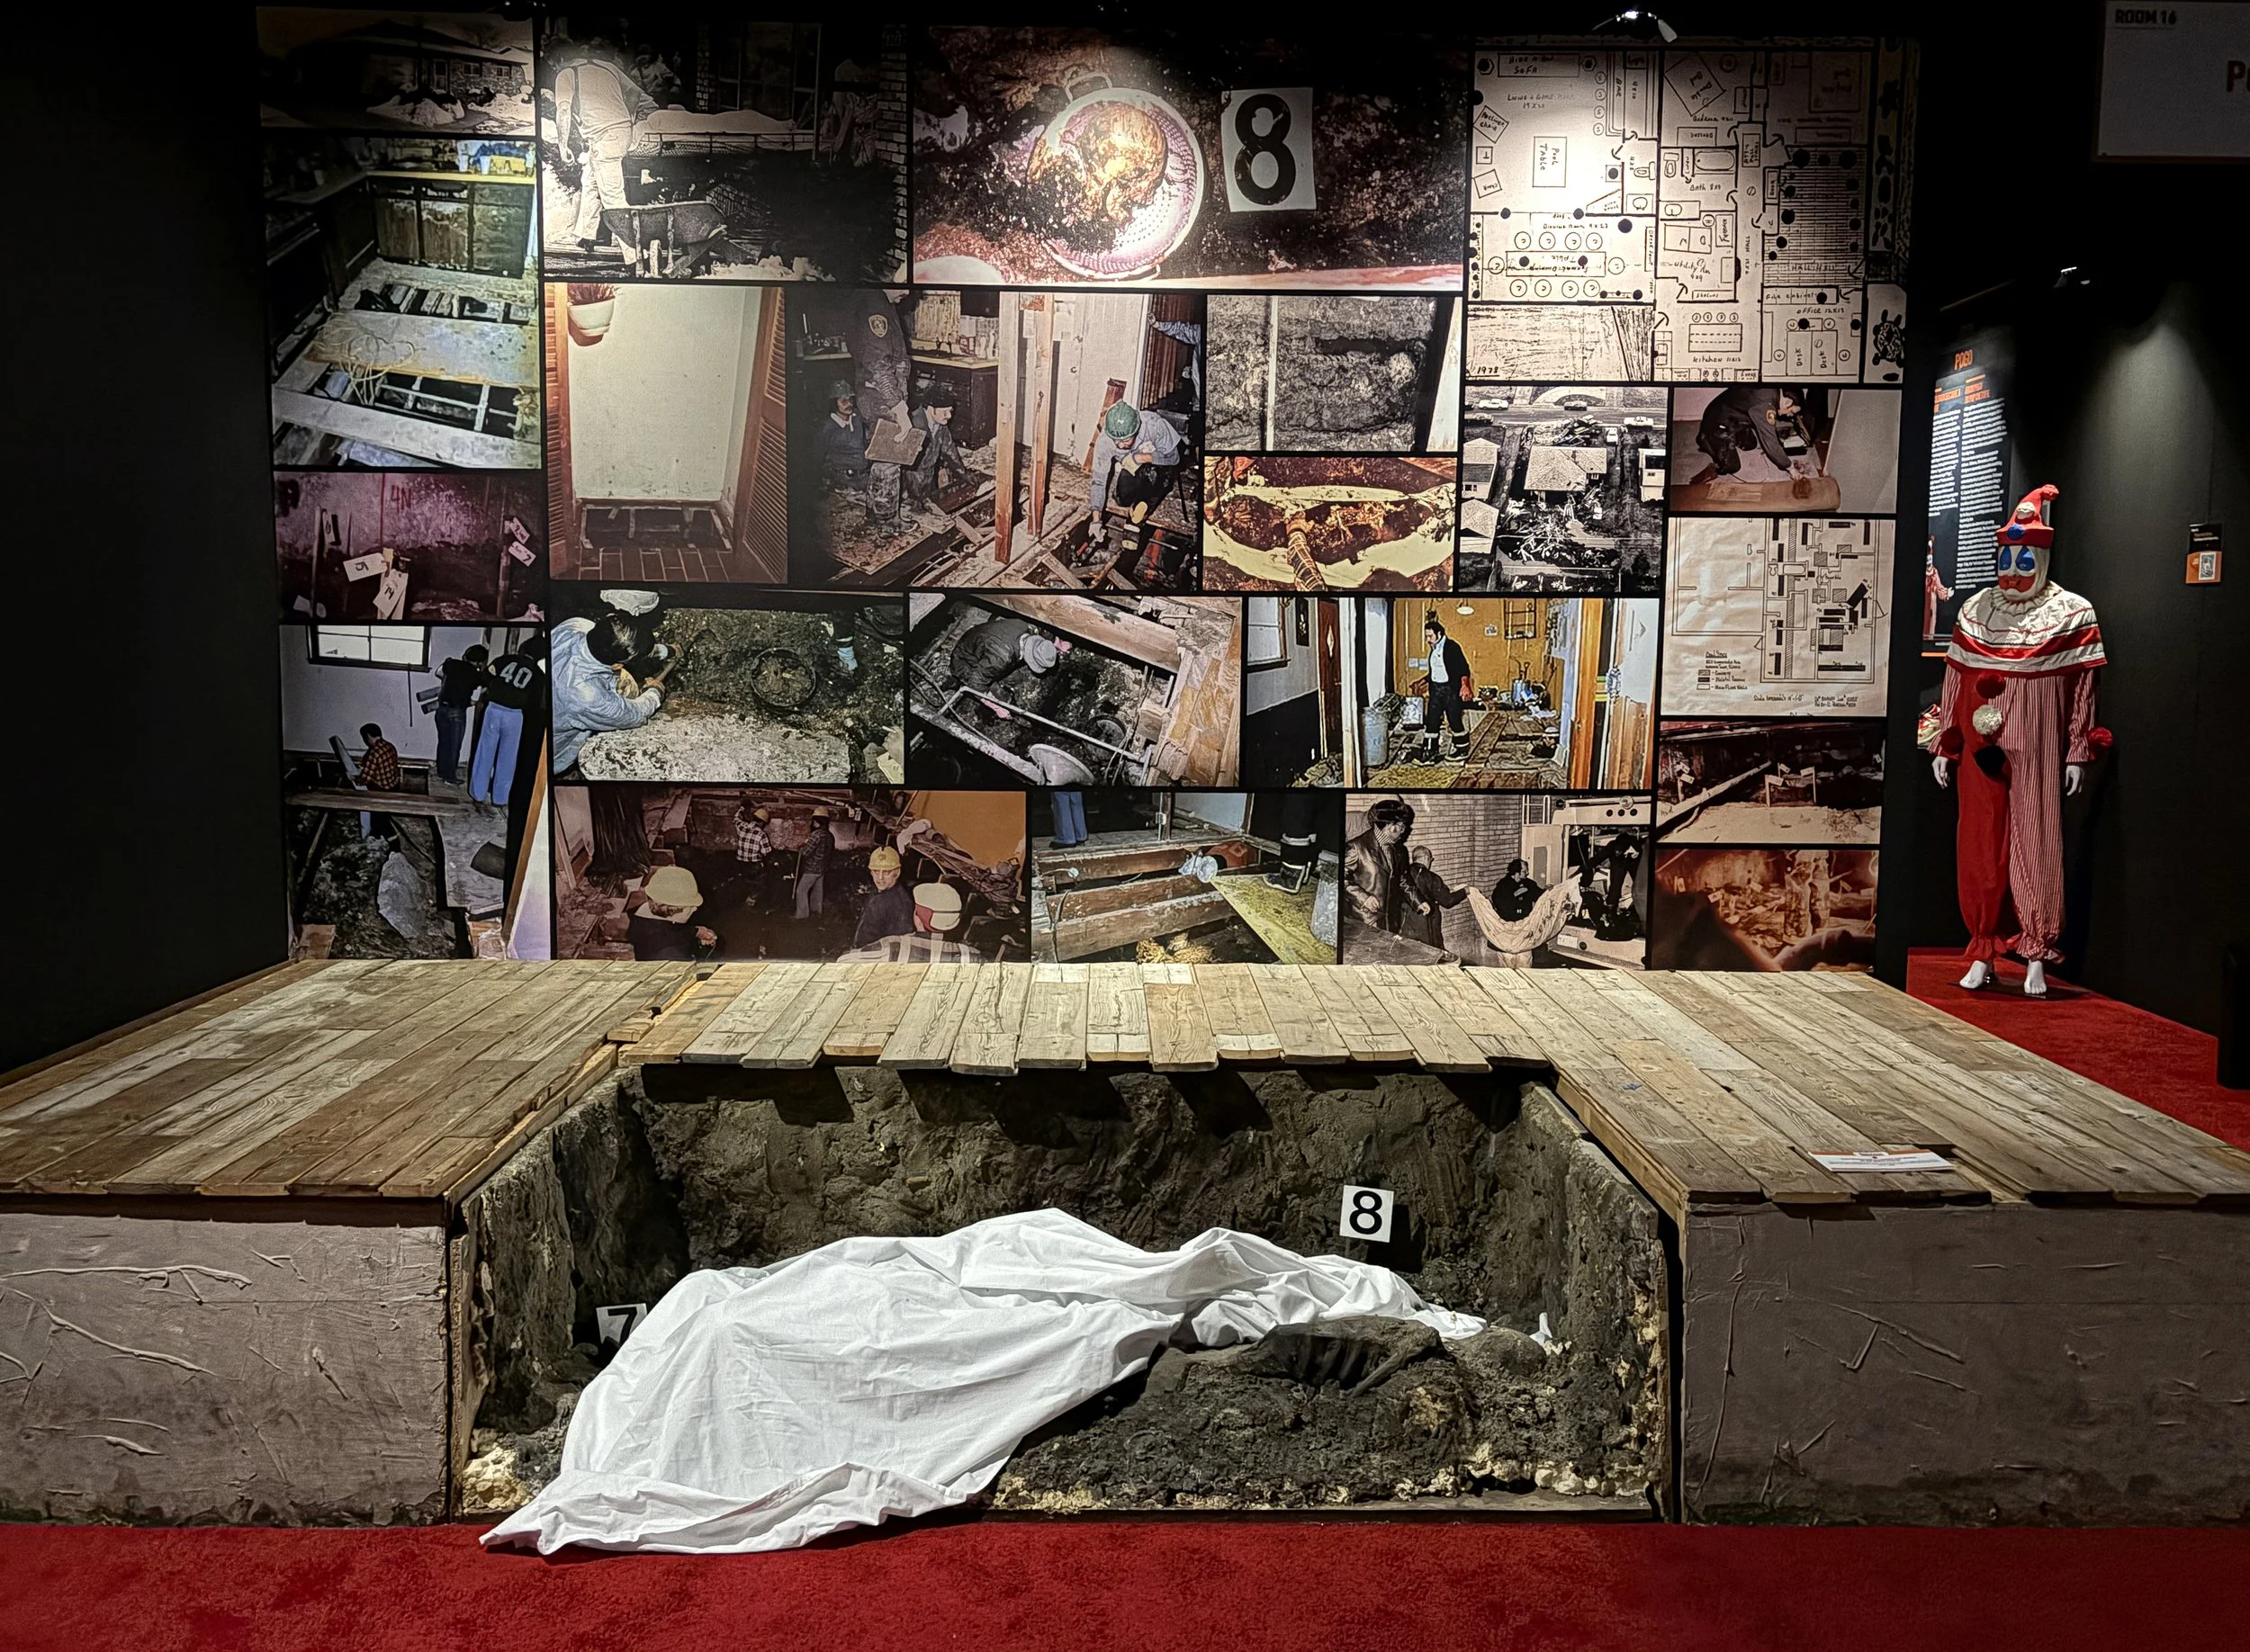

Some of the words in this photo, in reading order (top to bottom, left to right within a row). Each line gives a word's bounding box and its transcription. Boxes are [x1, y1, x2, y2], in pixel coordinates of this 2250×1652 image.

[2115, 9, 2157, 23] ROOM
[2161, 10, 2177, 25] 16
[2227, 60, 2250, 93] P
[1234, 93, 1297, 206] 8
[1477, 366, 1499, 374] 1978
[500, 661, 533, 689] 40
[1349, 1190, 1382, 1235] 8
[608, 1306, 638, 1349] 7
